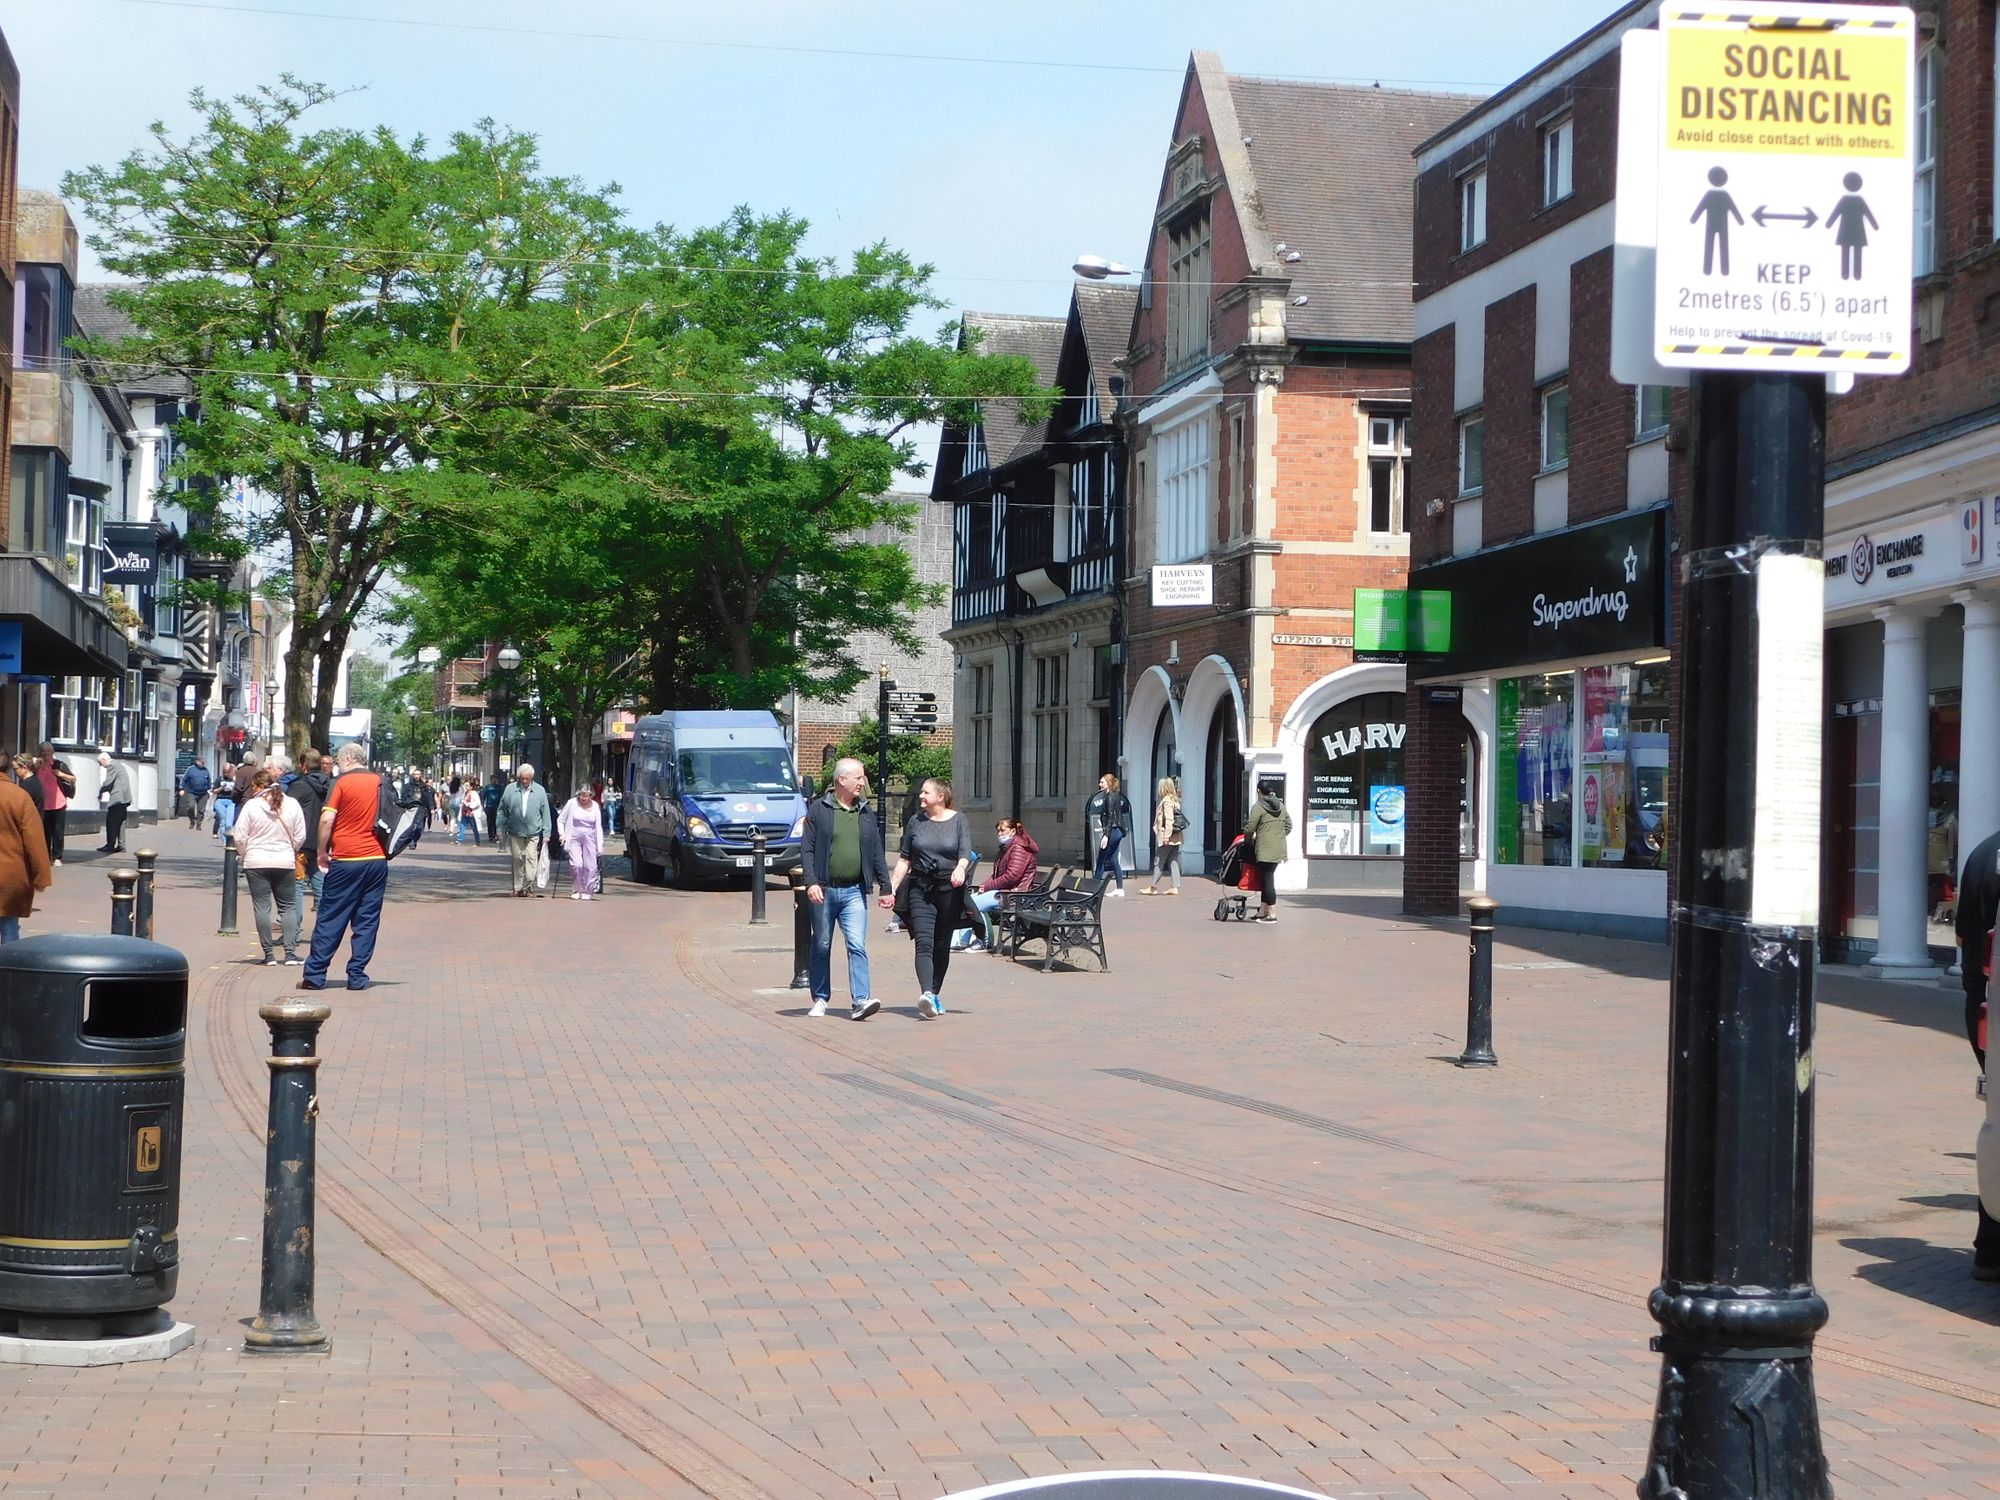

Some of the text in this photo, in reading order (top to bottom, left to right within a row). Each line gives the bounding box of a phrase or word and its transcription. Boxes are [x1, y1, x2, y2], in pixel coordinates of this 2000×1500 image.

[1724, 43, 1850, 81] SOCIAL
[1680, 85, 1893, 127] DISTANCING
[1677, 128, 1895, 150] Avoid close contact with others.
[1757, 263, 1812, 285] KEEP
[1678, 287, 1763, 311] 2metres
[1835, 294, 1889, 319] apart
[1669, 325, 1893, 344] Help to prevent the spread of Covid-19
[127, 551, 139, 559] the
[1876, 534, 1924, 565] EXCHANGE
[1160, 569, 1205, 578] HARVEYS
[1823, 555, 1847, 578] MENT
[1359, 592, 1403, 600] PHARMACY
[1532, 586, 1629, 631] Superdrug
[1275, 635, 1352, 646] TIPPING STR
[1321, 723, 1407, 761] HARV
[1313, 775, 1353, 783] SHOE REPAIRS
[1308, 797, 1358, 806] WATCH BATTERIES
